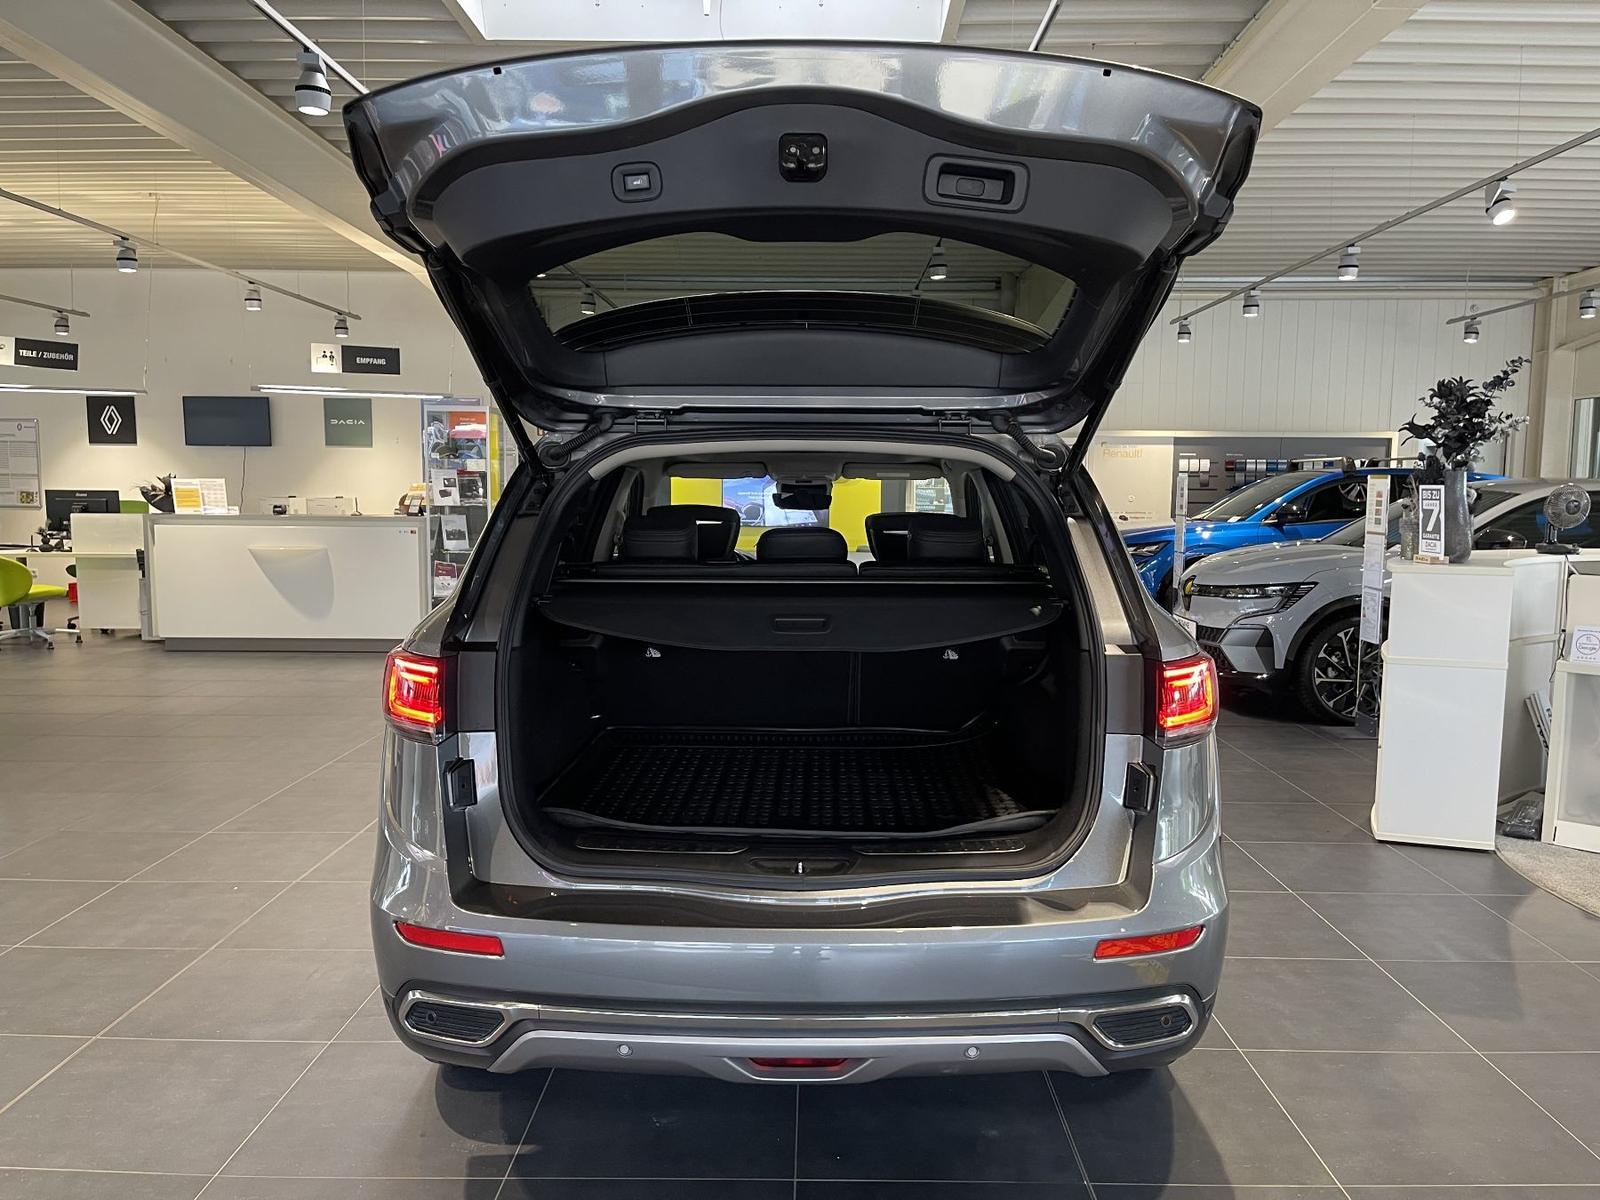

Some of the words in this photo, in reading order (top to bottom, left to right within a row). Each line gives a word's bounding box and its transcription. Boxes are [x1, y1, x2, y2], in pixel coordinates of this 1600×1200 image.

[19, 349, 37, 358] TEILE
[43, 351, 74, 361] ZUBEHÖR
[356, 357, 386, 365] EMPFANG
[1422, 490, 1432, 499] BIS
[1432, 490, 1440, 500] ZU
[1422, 500, 1440, 532] 7
